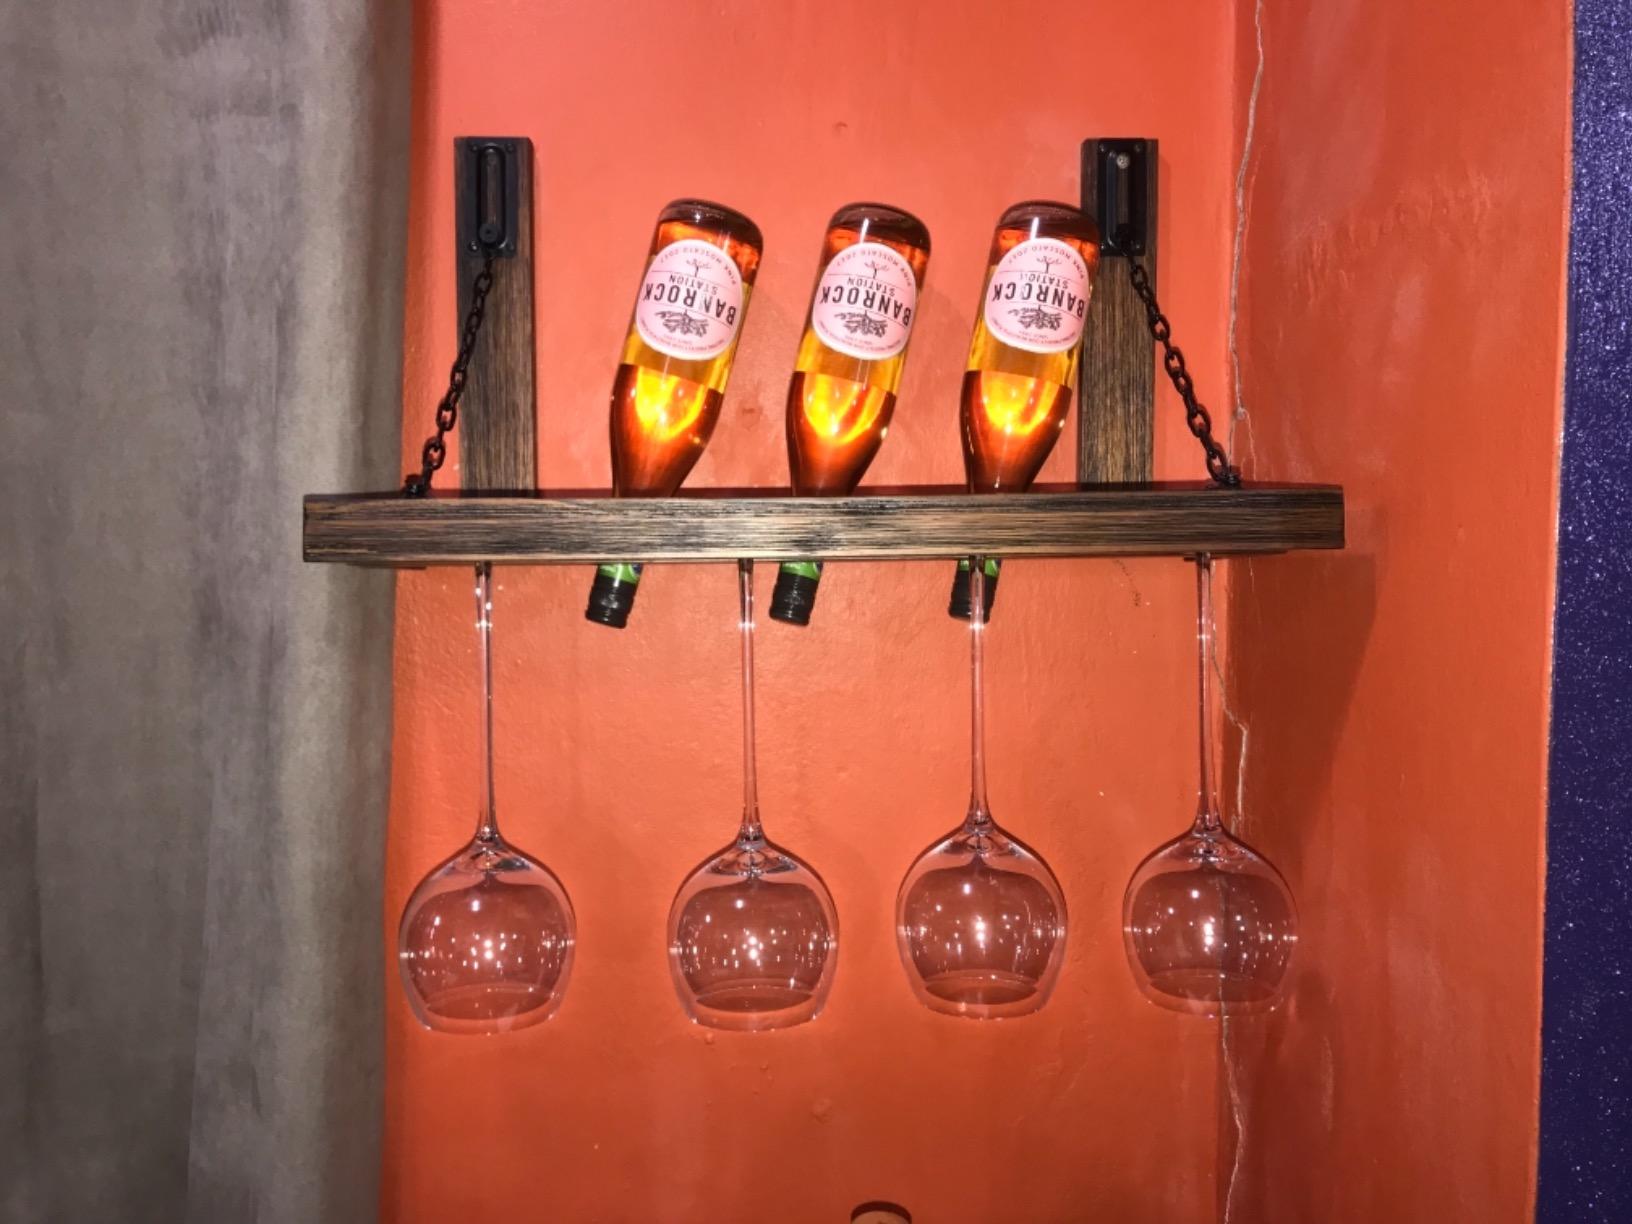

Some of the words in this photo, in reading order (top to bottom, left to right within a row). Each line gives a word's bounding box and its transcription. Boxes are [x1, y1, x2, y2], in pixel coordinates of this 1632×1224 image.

[683, 247, 721, 263] MOSCATO
[861, 250, 898, 266] MOSCATO
[1031, 246, 1070, 259] MOSCATO
[669, 274, 717, 295] STATION
[847, 277, 895, 297] STATION
[644, 283, 736, 325] BANROCK
[820, 286, 911, 326] BANROCK
[993, 282, 1085, 318] BANROCK
